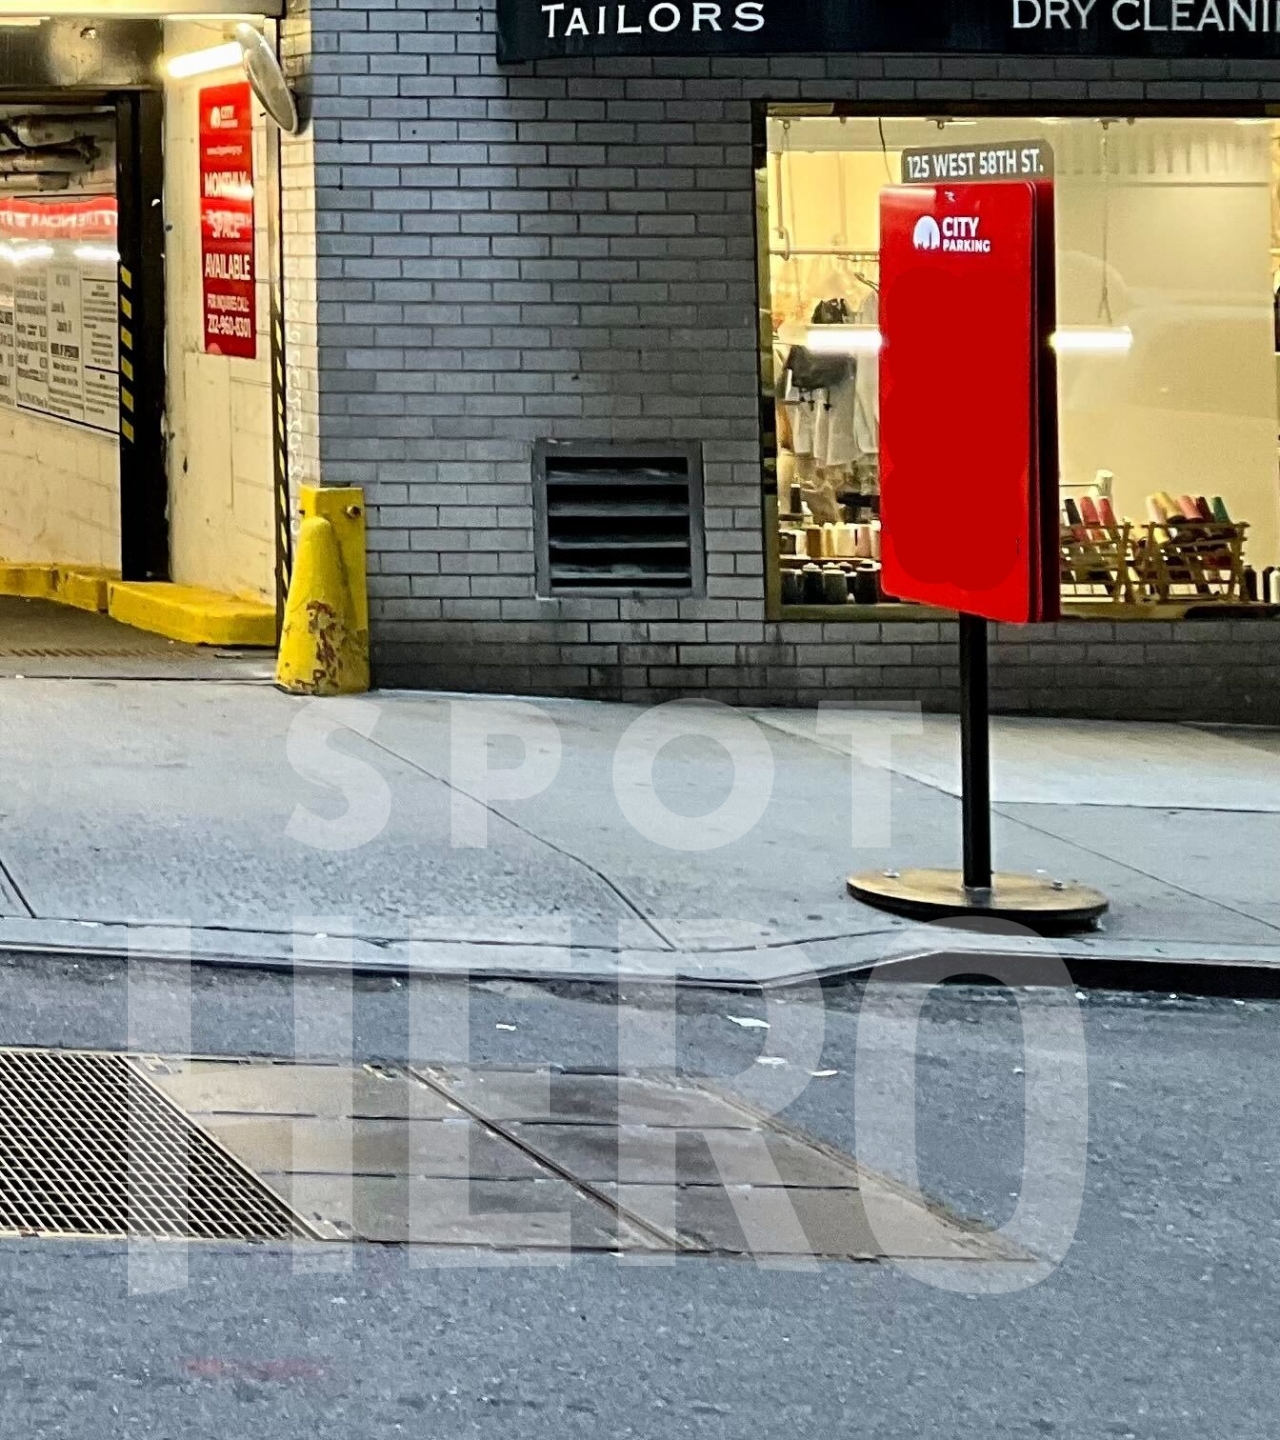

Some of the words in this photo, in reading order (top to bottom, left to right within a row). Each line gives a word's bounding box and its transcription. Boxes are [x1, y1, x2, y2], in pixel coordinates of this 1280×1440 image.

[541, 2, 766, 38] TAILORS
[907, 155, 930, 179] 125
[932, 152, 976, 177] WEST
[979, 149, 1016, 175] 58TH
[1021, 148, 1044, 173] ST.
[942, 216, 980, 237] CITY
[942, 239, 991, 252] PARKING
[204, 253, 251, 281] AVAILABLE
